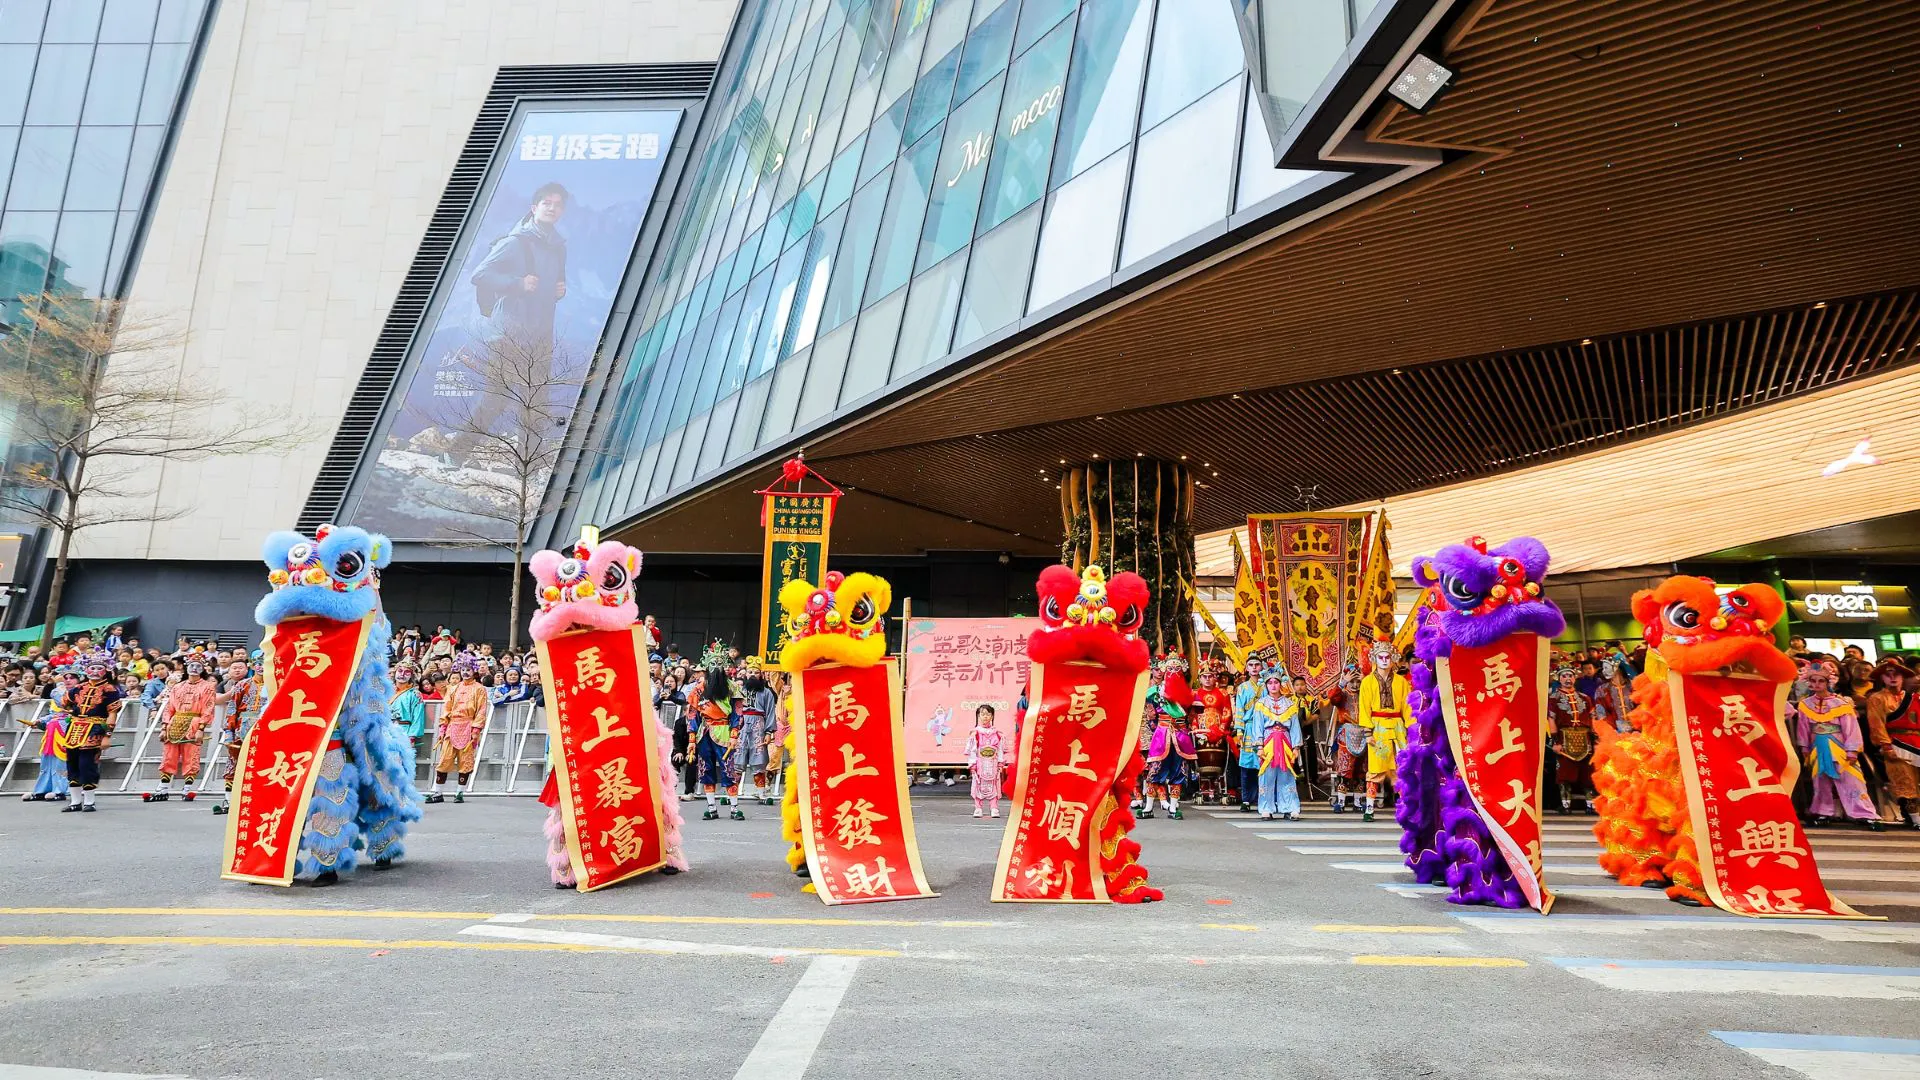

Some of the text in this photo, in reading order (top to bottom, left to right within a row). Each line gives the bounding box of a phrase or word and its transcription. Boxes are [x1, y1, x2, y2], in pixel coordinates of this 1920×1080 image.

[520, 133, 659, 161] 超级安踏
[1804, 594, 1878, 615] green
[253, 630, 332, 857] 馬上好運
[571, 646, 646, 866] 馬上暴富
[821, 681, 897, 896] 馬上發財
[1024, 684, 1107, 899] 馬上順利
[1712, 694, 1828, 915] 馬上興旺
